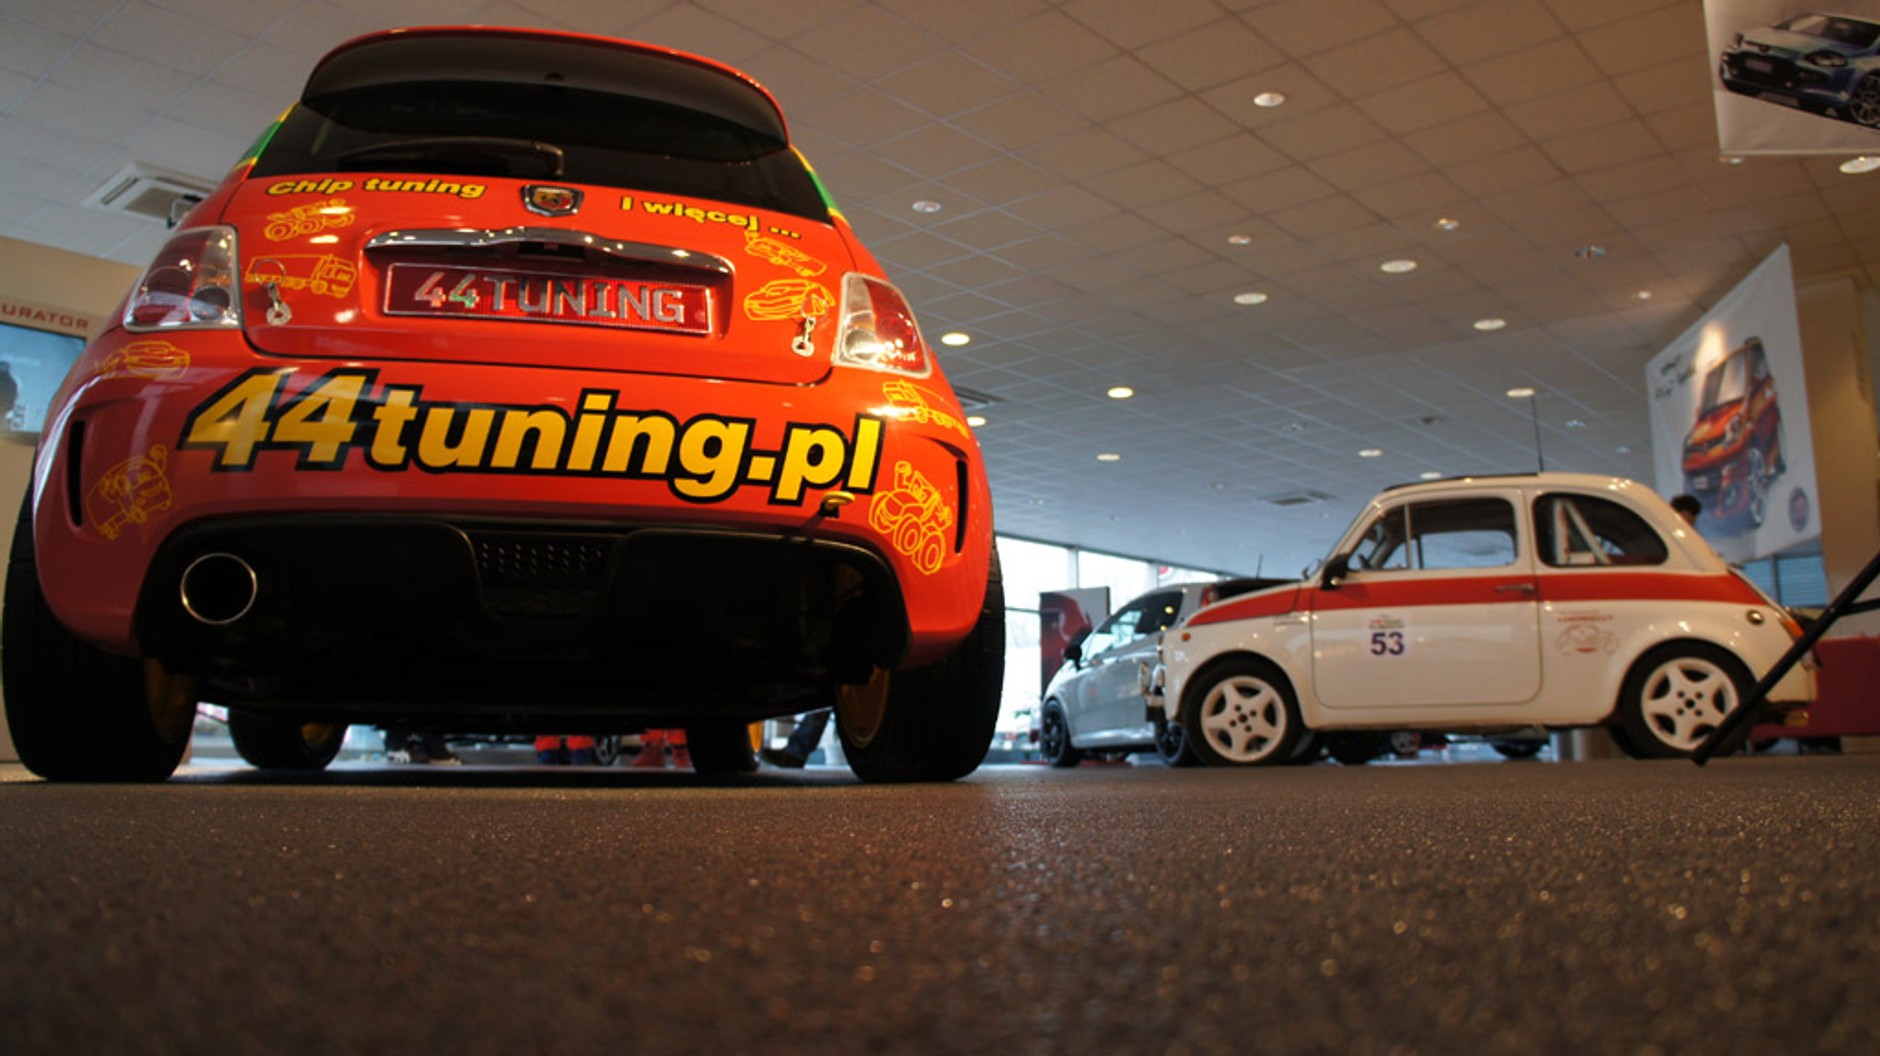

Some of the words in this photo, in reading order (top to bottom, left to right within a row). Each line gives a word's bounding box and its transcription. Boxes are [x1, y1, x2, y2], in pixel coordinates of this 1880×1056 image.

[364, 177, 487, 199] tuning
[413, 271, 686, 324] 44TUNING
[1, 303, 90, 329] URATOR
[178, 366, 885, 505] 44tuning.pl
[1370, 631, 1405, 656] 53
